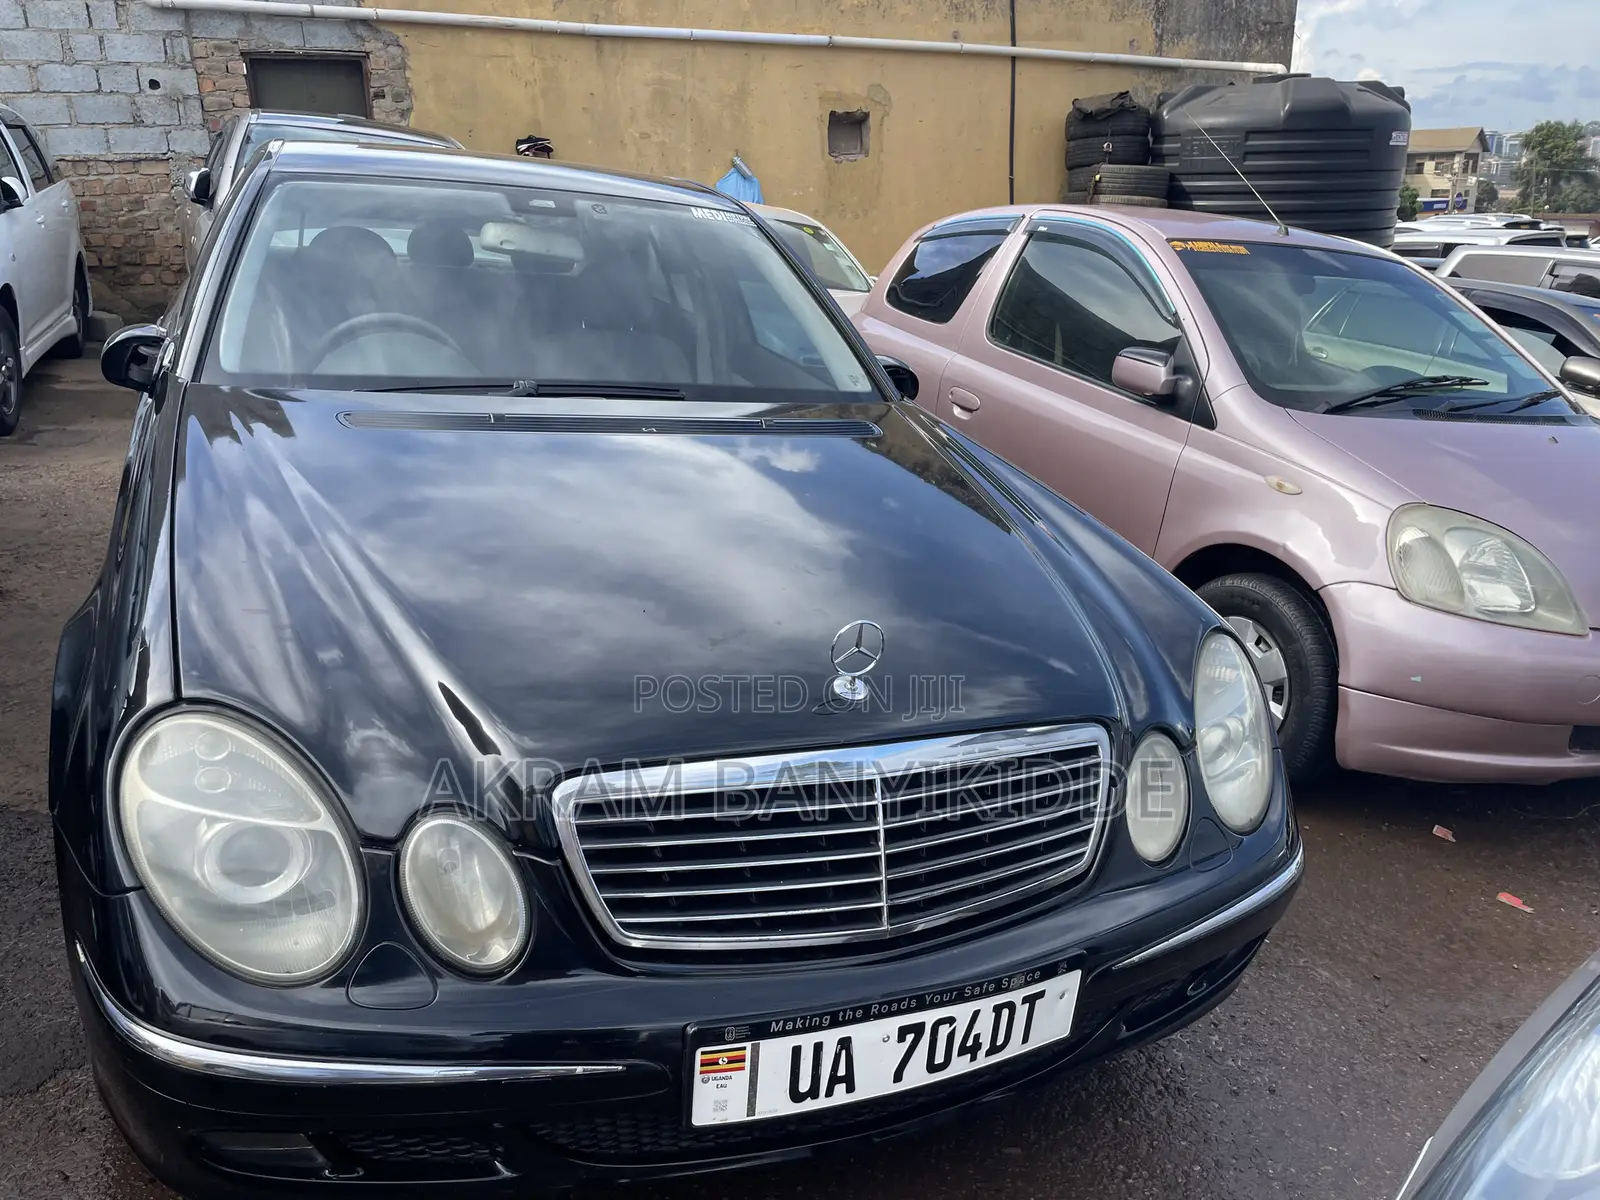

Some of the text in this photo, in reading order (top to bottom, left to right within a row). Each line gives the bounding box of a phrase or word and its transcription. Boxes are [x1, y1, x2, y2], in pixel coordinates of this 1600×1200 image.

[770, 1012, 830, 1033] Making
[838, 1007, 864, 1022] the
[870, 999, 918, 1016] Roads
[925, 989, 958, 1005] Your
[964, 982, 995, 998] Safe
[1001, 970, 1041, 990] Space
[788, 989, 1046, 1104] UA 704DT
